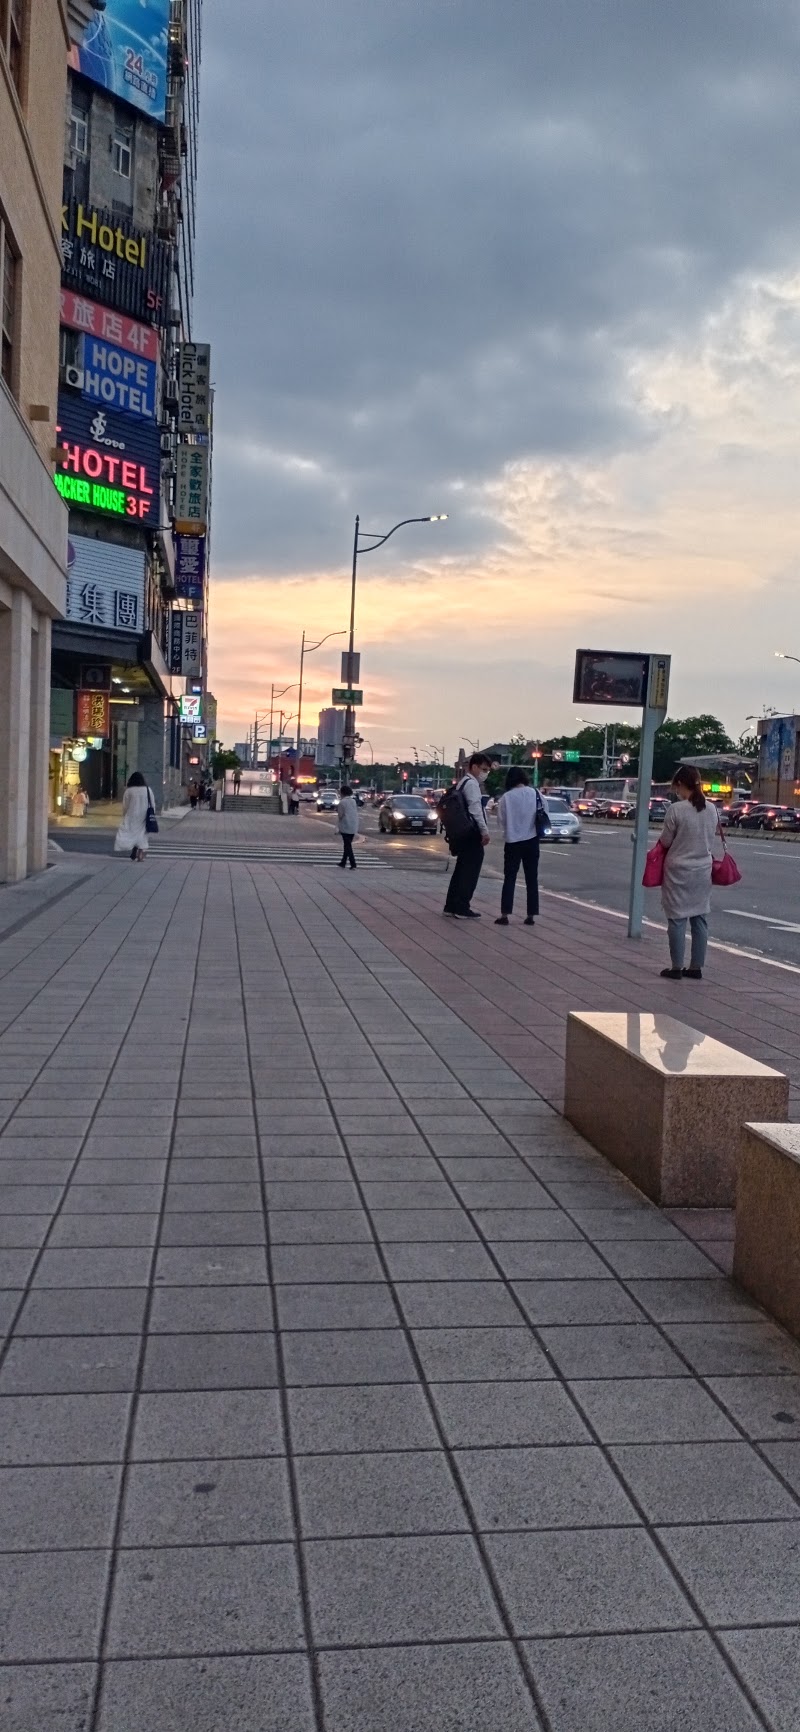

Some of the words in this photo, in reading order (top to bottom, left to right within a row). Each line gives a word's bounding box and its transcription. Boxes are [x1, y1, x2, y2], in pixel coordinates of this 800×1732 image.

[125, 48, 143, 75] 24
[76, 203, 146, 269] Hotel
[146, 290, 163, 311] 5F
[92, 344, 149, 386] HOPE
[182, 343, 197, 378] Click
[84, 370, 153, 417] HOTEL
[181, 382, 195, 424] Hotel
[62, 441, 153, 495] HOTEL
[92, 484, 125, 514] HOUSE
[126, 496, 151, 518] 3F
[175, 575, 202, 584] HOTEL
[67, 582, 139, 631] 集團
[184, 615, 198, 661] 巴菲特
[195, 725, 206, 738] P
